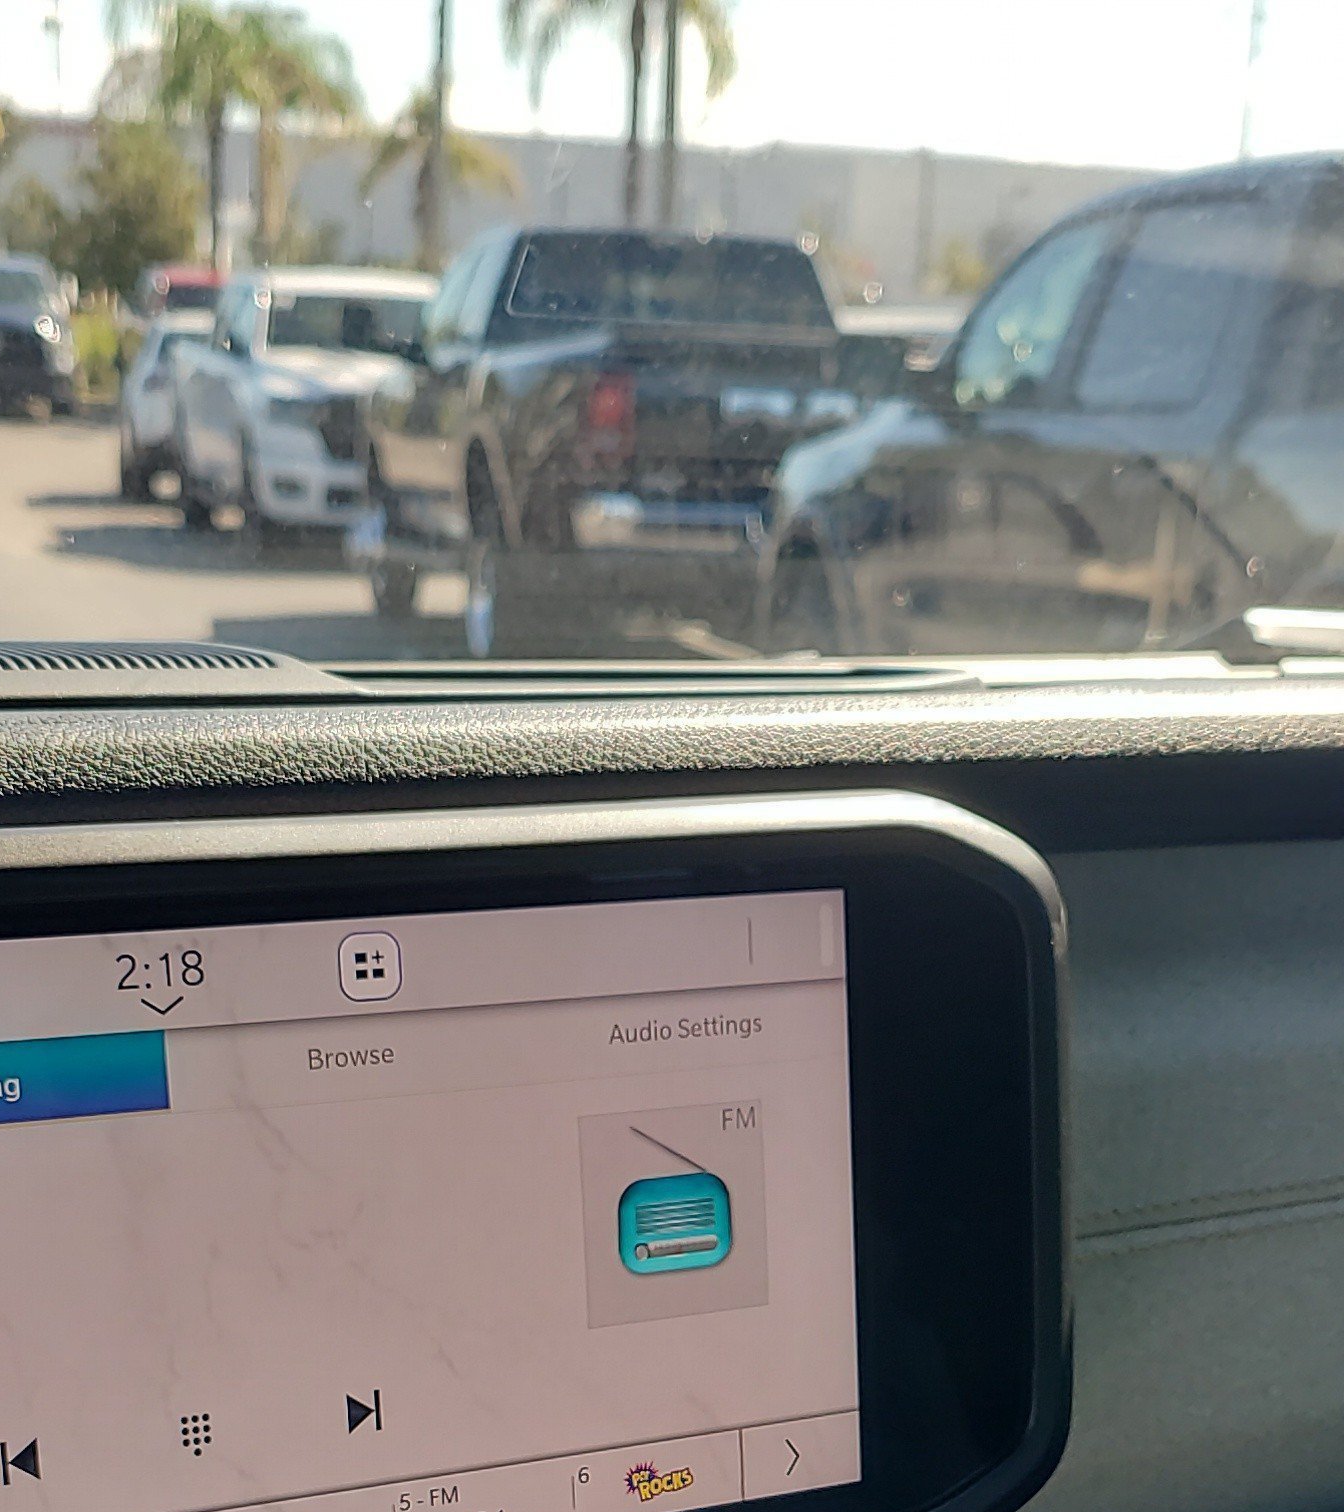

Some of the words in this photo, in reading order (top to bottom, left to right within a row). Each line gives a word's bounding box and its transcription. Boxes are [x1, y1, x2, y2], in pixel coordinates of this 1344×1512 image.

[115, 950, 205, 992] 2:18
[609, 1019, 673, 1046] Audio
[677, 1012, 763, 1045] Settings
[307, 1042, 394, 1071] Browse
[721, 1105, 757, 1133] FM
[578, 1466, 590, 1484] 6
[638, 1468, 694, 1502] ROCKS
[398, 1492, 411, 1512] 5
[429, 1485, 459, 1507] FM
